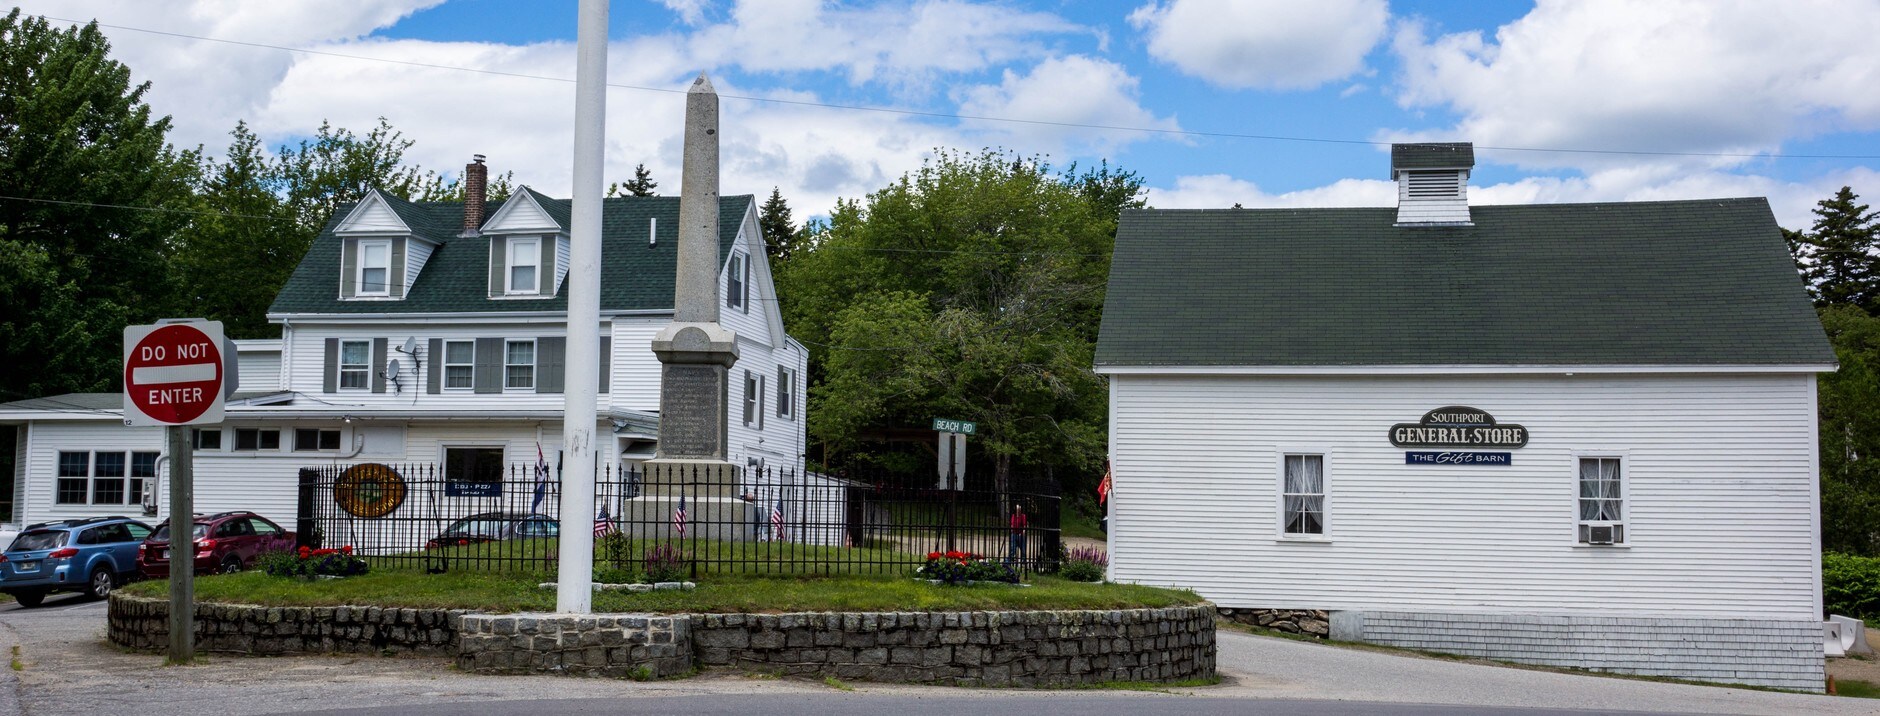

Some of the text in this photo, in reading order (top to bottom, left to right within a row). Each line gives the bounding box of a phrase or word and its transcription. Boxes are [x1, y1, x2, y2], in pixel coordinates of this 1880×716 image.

[142, 343, 209, 361] DO NOT
[148, 387, 203, 405] ENTER
[1430, 412, 1485, 423] SOUTHPORT
[936, 420, 973, 433] BEACH RD
[1435, 451, 1473, 464] Gift
